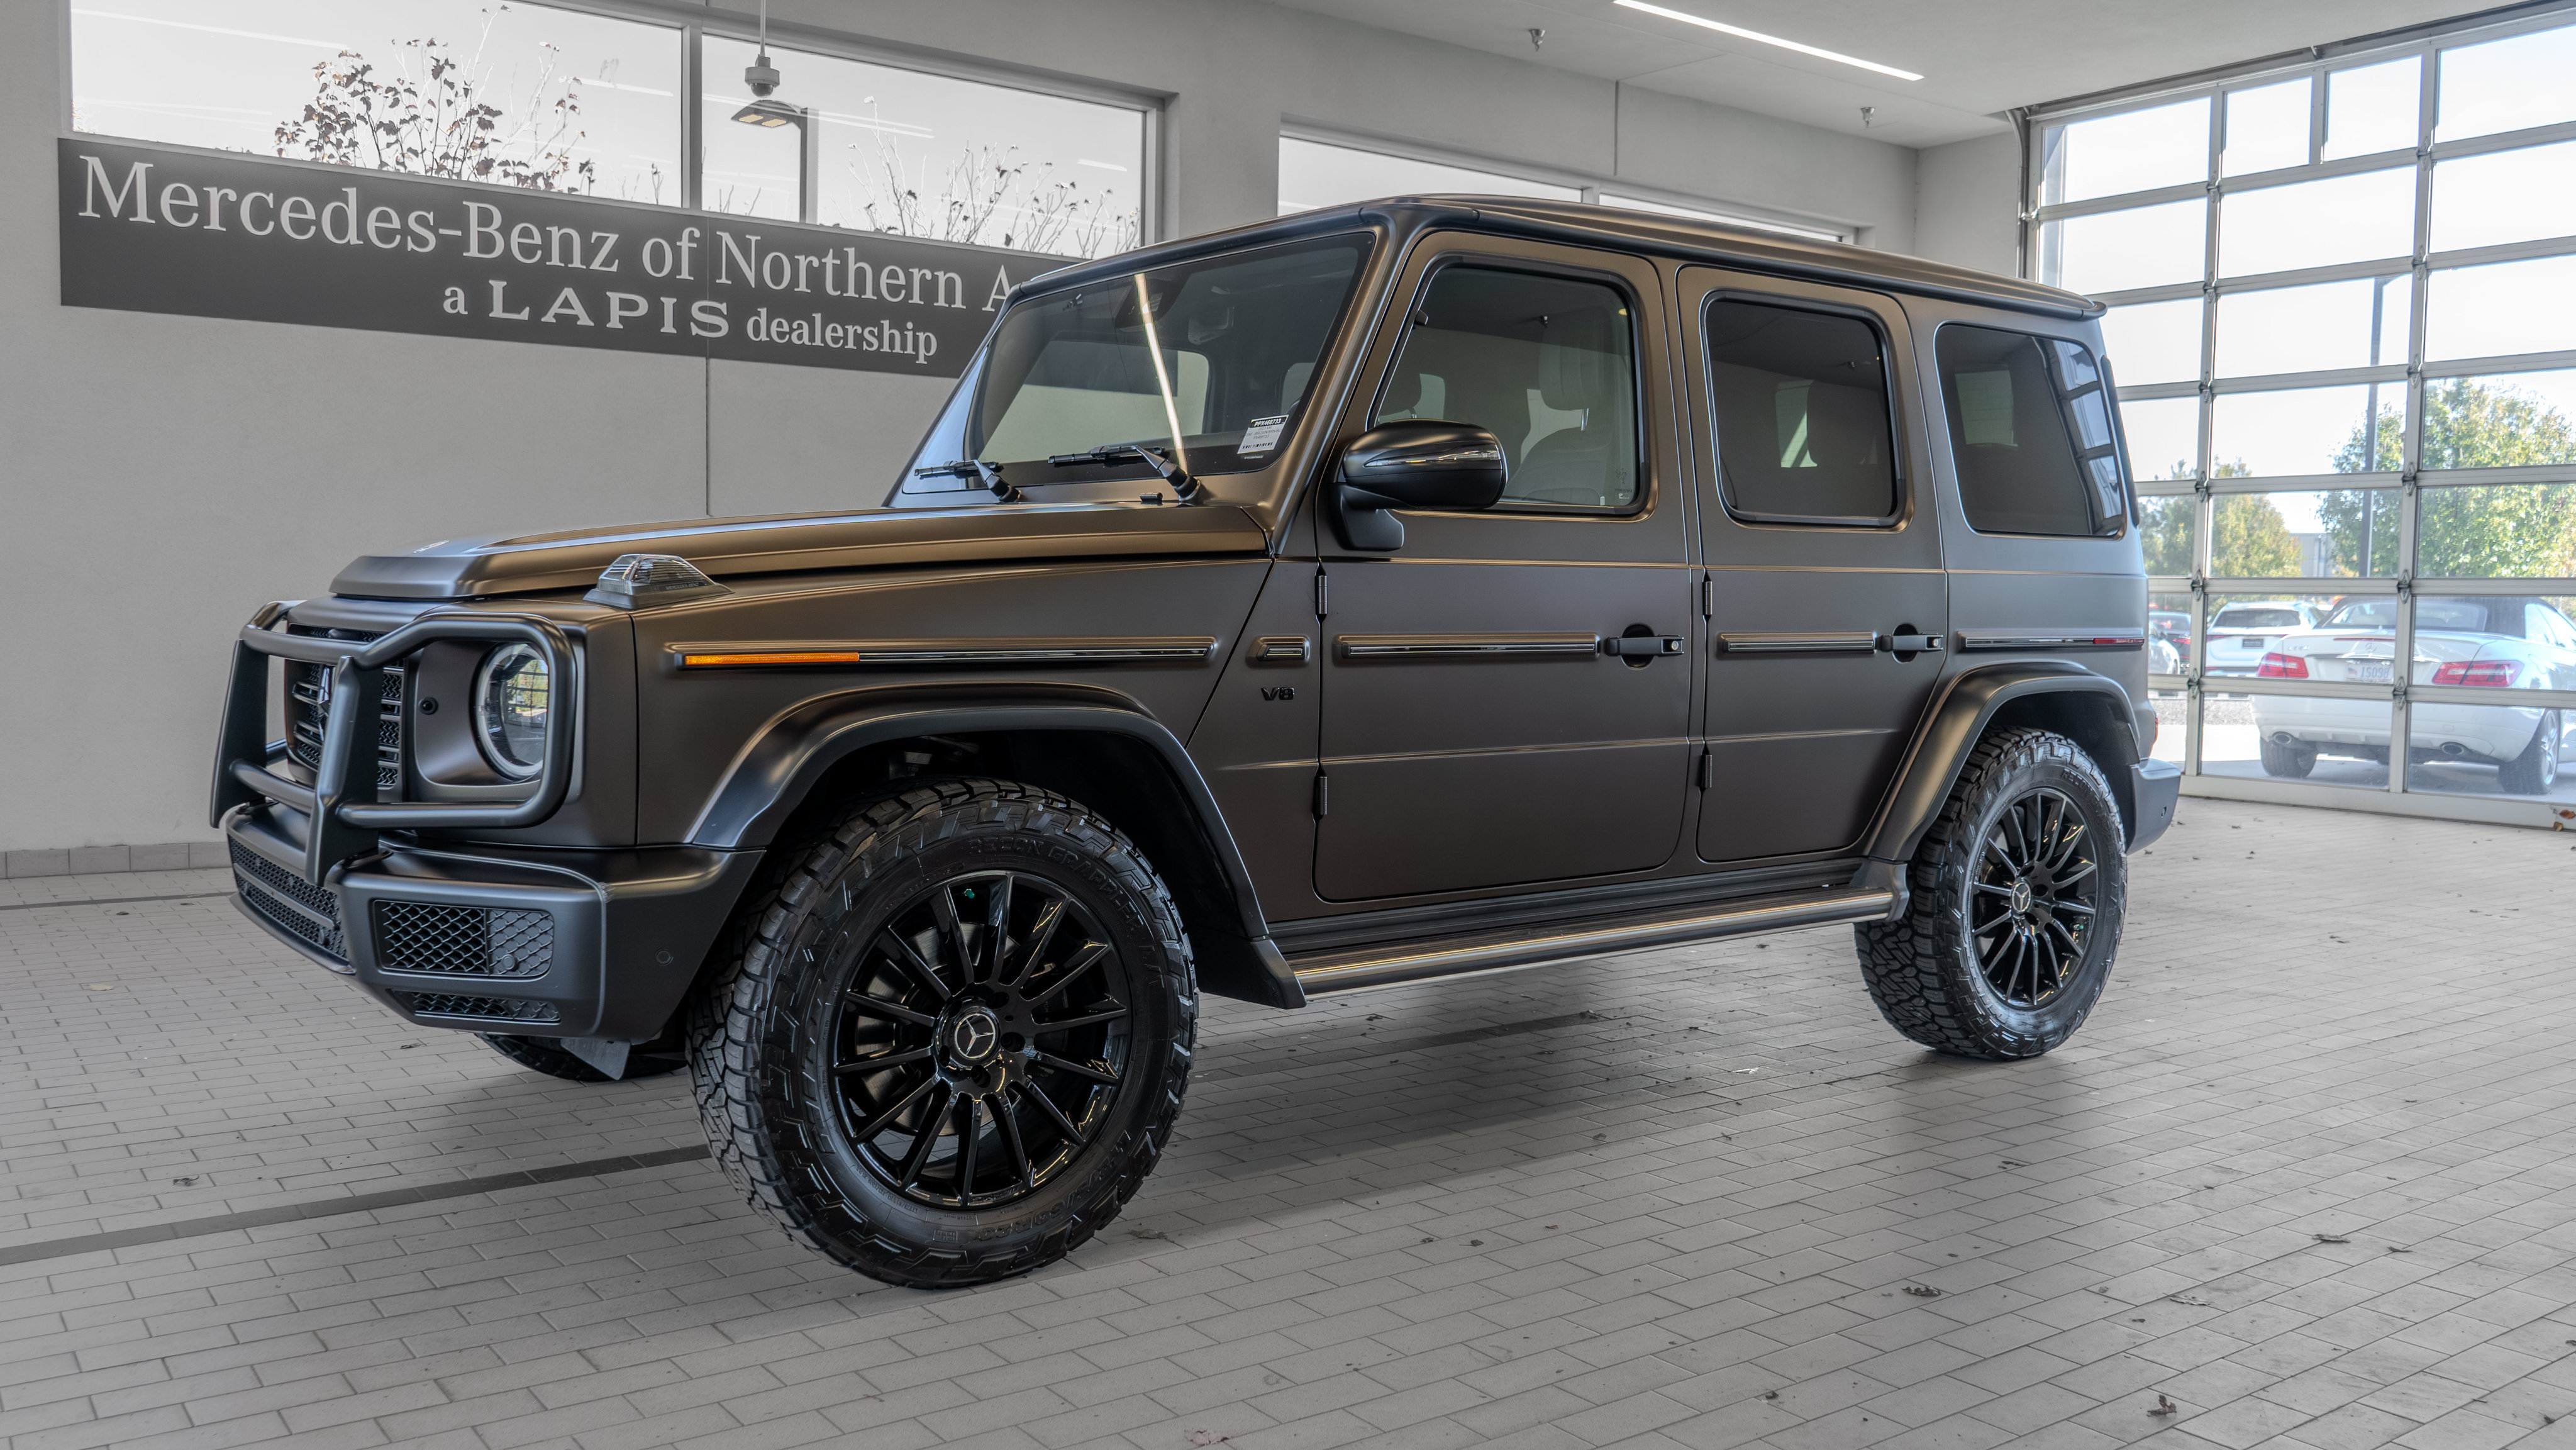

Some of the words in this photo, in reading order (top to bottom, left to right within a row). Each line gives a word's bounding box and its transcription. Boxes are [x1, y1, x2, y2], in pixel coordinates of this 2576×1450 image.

[77, 155, 620, 273] Mercedes-Benz
[641, 226, 701, 281] of
[715, 230, 967, 310] Northern
[442, 286, 469, 315] a
[487, 279, 730, 338] LAPIS
[746, 306, 938, 365] dealership
[1260, 687, 1295, 701] V8
[1047, 845, 1144, 932] GRAPPLER
